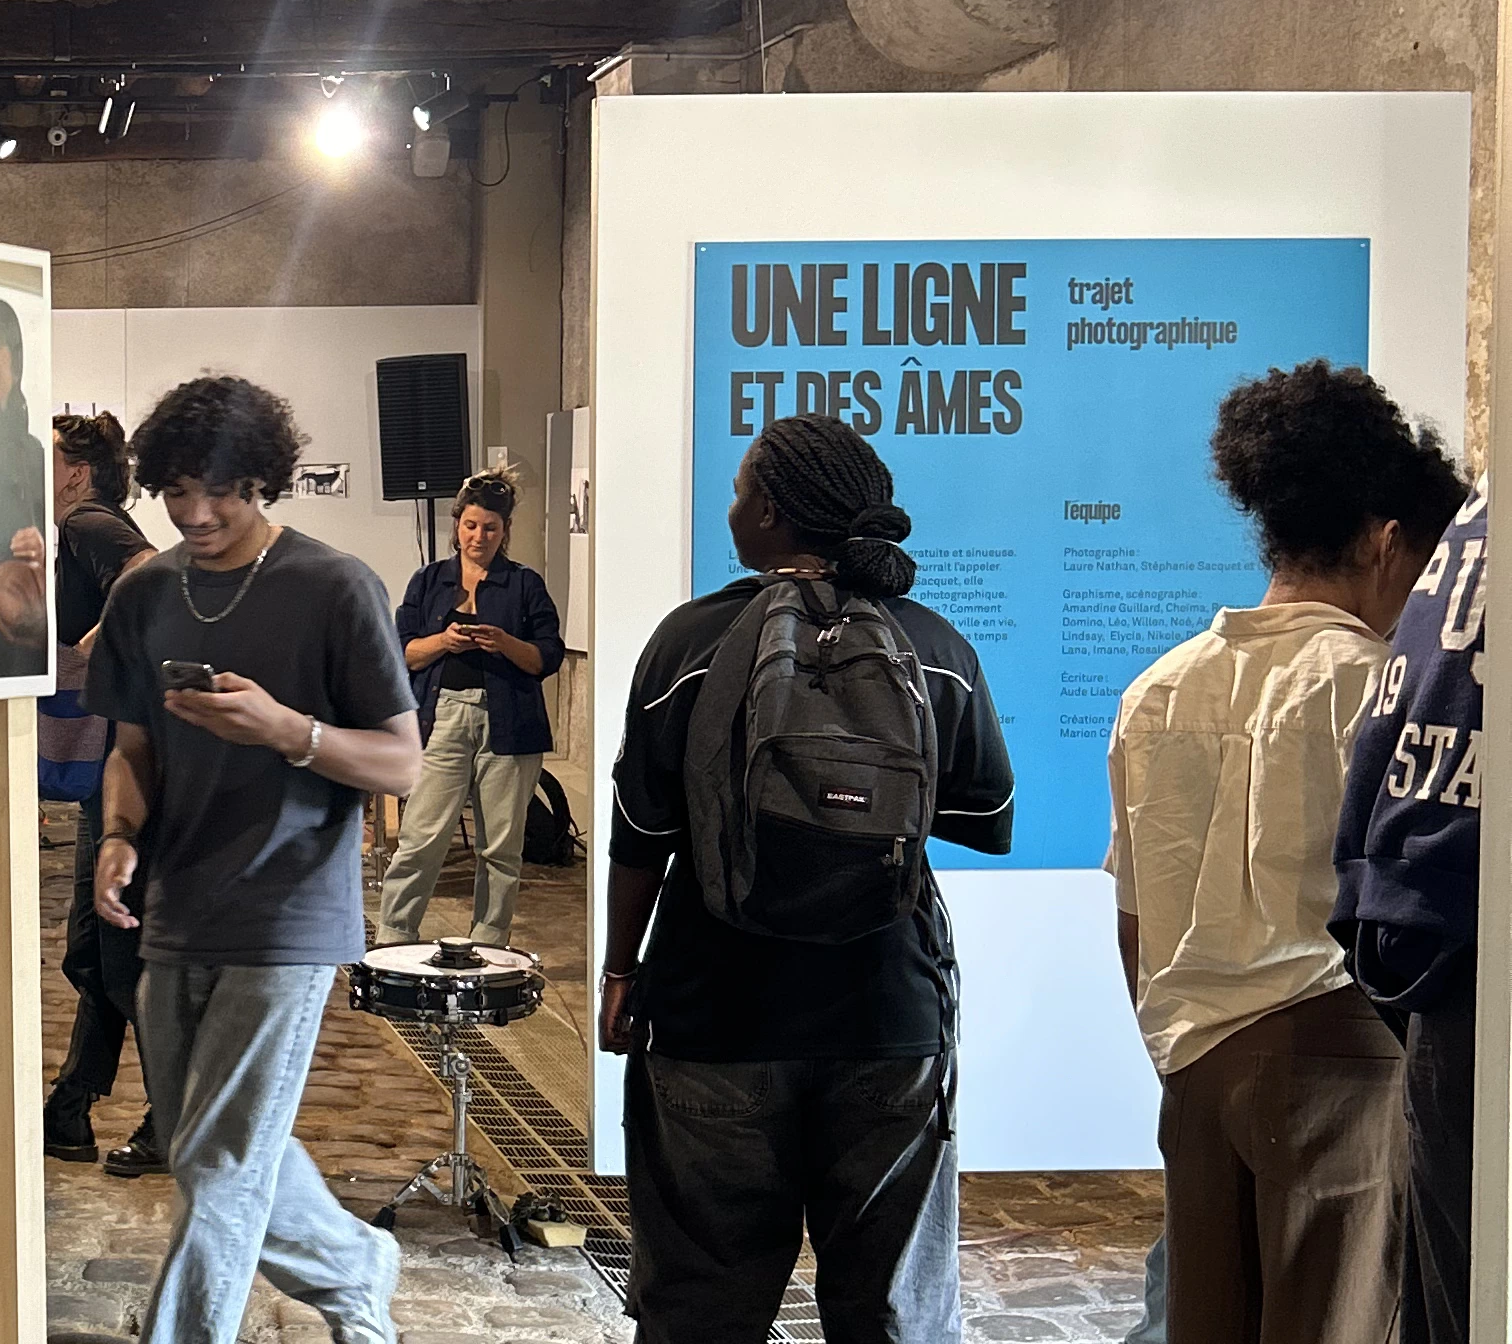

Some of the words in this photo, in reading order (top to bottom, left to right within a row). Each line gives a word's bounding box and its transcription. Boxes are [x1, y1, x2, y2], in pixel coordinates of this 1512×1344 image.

[1068, 277, 1134, 311] trajet
[731, 263, 848, 348] UNE
[862, 262, 1027, 347] LIGNE
[1067, 316, 1238, 351] photographique
[730, 371, 784, 436] ET
[795, 369, 882, 436] DES
[894, 356, 1023, 436] ÂMES
[1063, 499, 1121, 525] l'équipe
[952, 549, 964, 557] et
[965, 546, 1017, 557] sinueuse.
[1063, 561, 1094, 572] Laure
[1096, 561, 1139, 573] Nathan,
[1140, 560, 1195, 573] Stéphanie
[1197, 560, 1241, 574] Sacquet
[915, 575, 962, 588] Sacquet,
[963, 575, 984, 586] elle
[919, 589, 1008, 602] photographique.
[1062, 588, 1124, 601] Graphisme,
[949, 603, 1003, 614] Comment
[1062, 602, 1117, 613] Amandine
[1118, 602, 1164, 614] Guillard,
[958, 616, 981, 628] ville
[982, 619, 996, 628] en
[998, 616, 1017, 629] vie,
[974, 632, 1009, 643] temps
[1062, 630, 1105, 643] Lindsay,
[1059, 686, 1088, 697] Aude
[1371, 654, 1408, 717] 19
[1059, 714, 1105, 725] Création
[1059, 728, 1097, 738] Marion
